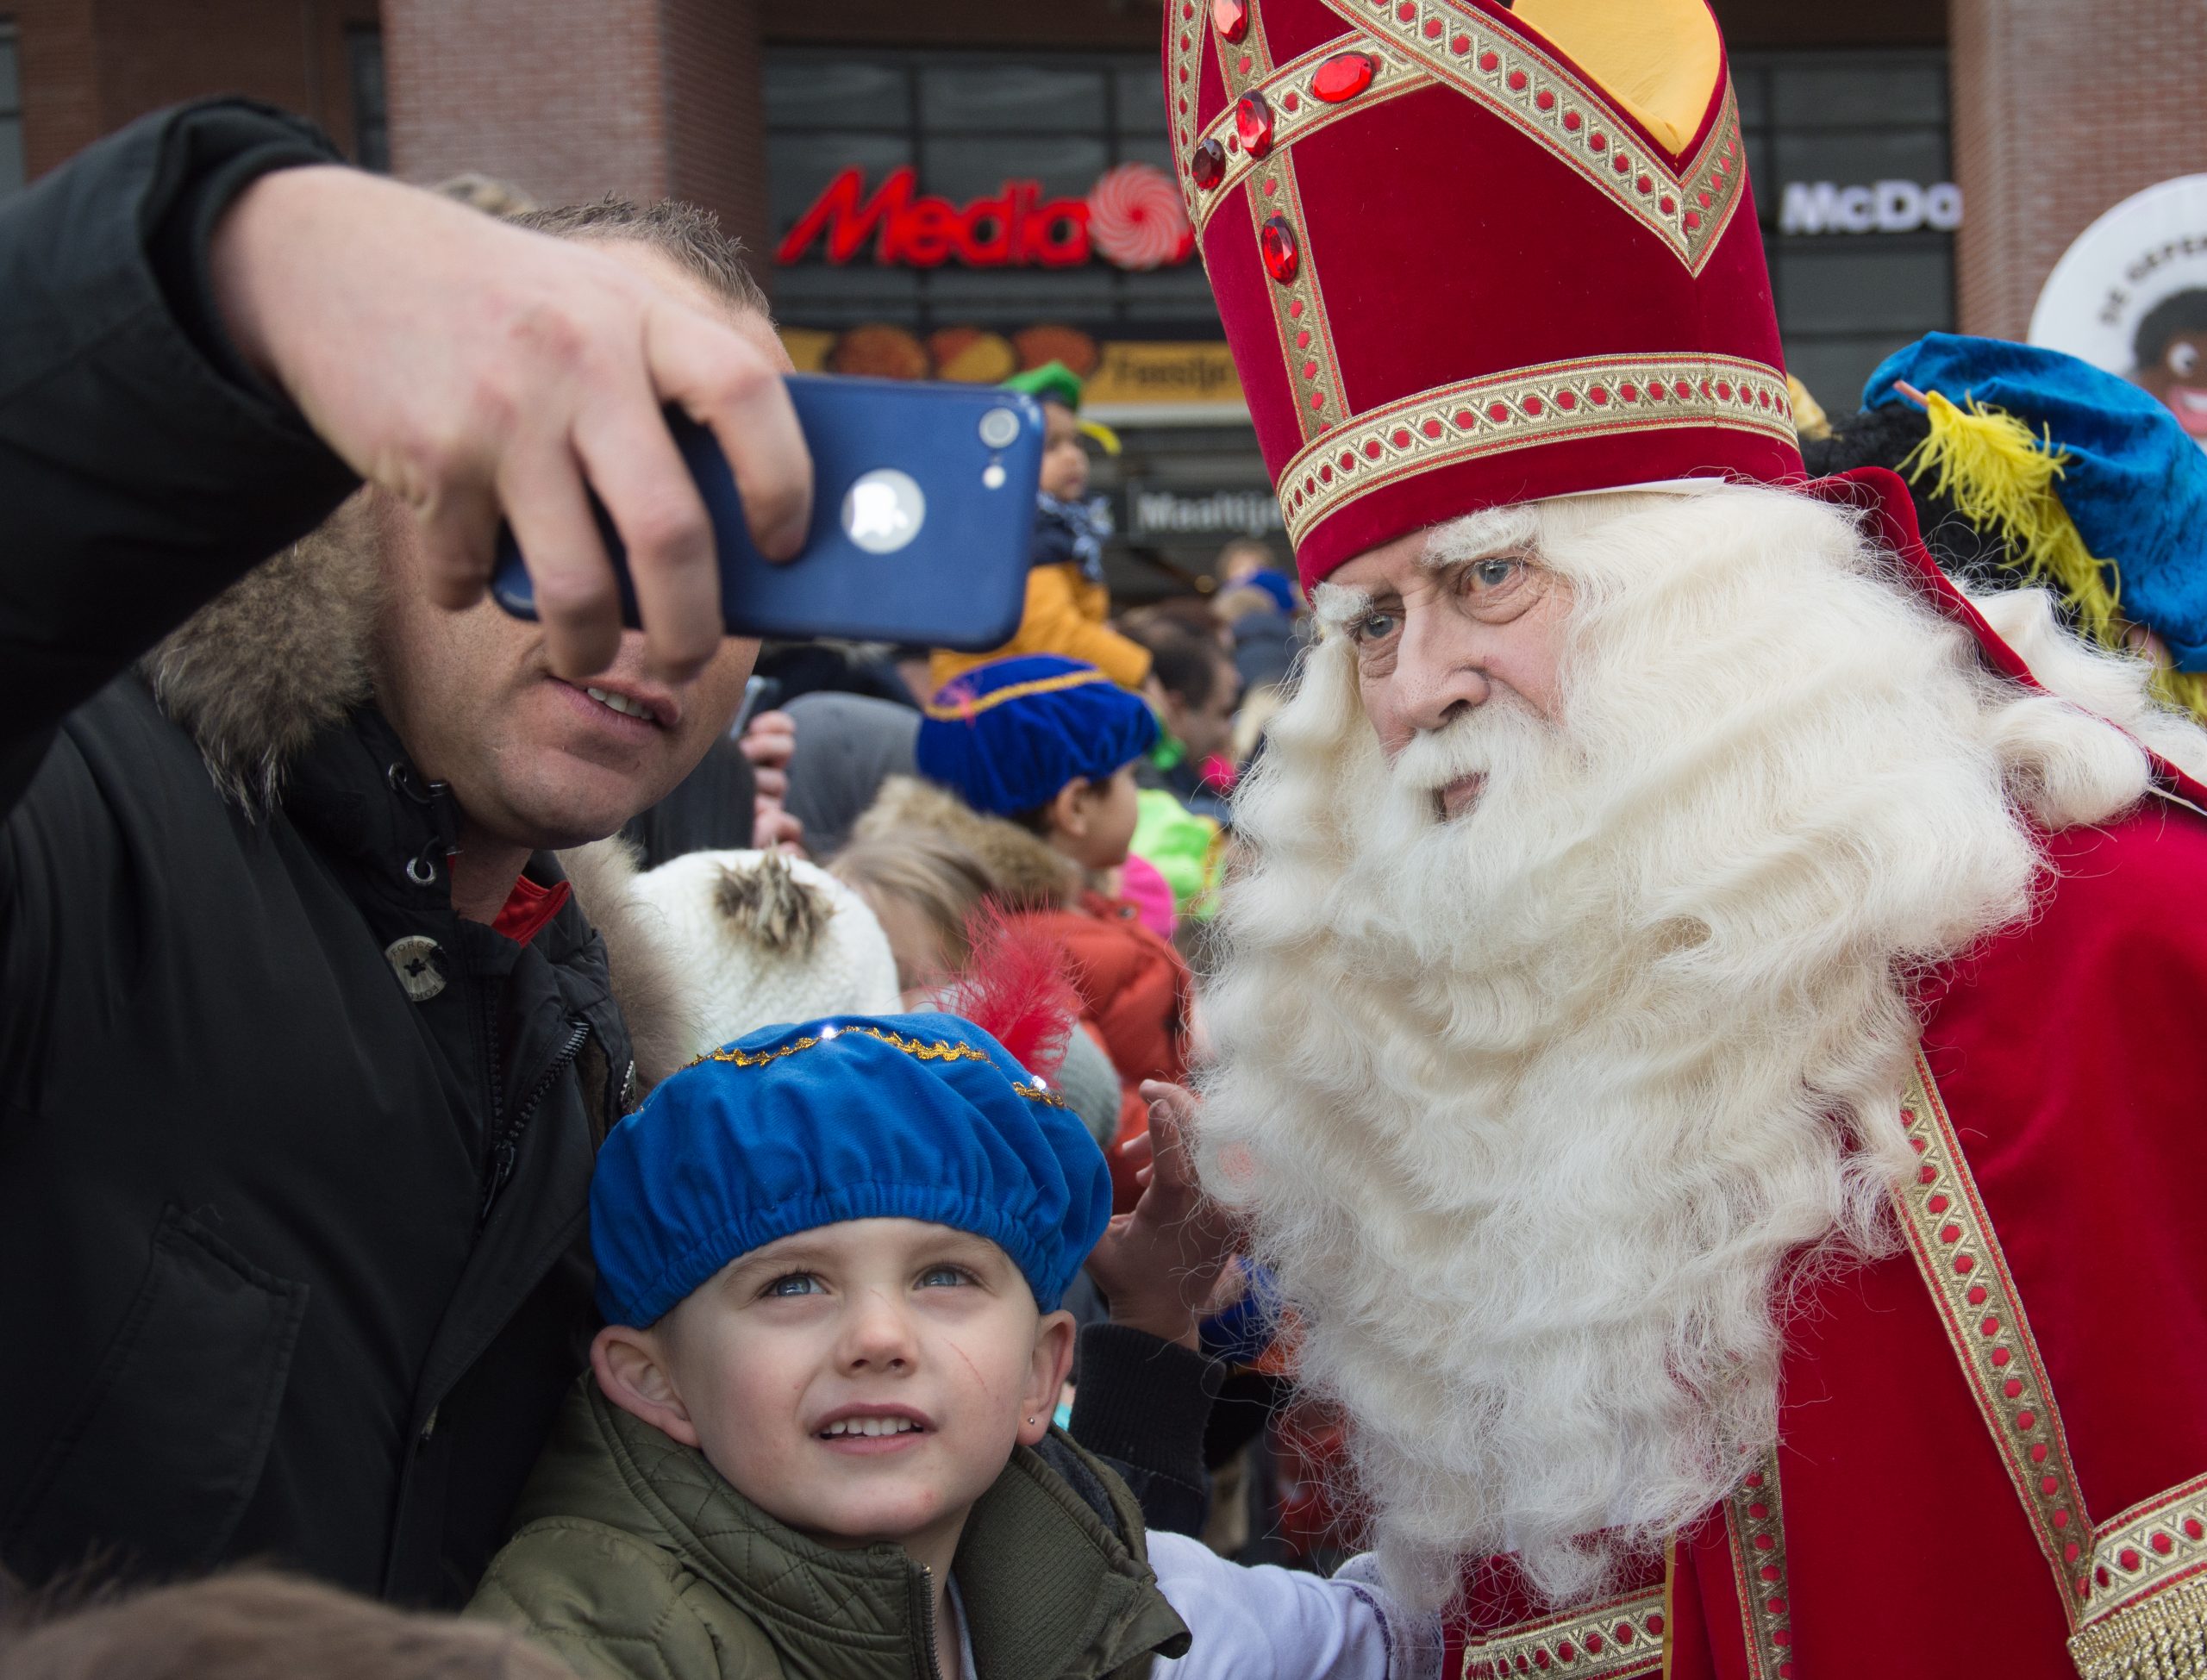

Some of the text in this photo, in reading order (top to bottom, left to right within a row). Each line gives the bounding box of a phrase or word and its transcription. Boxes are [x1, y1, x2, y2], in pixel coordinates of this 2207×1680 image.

[778, 166, 1091, 264] Media
[1779, 180, 1964, 234] McDo
[391, 940, 434, 957] FORCE
